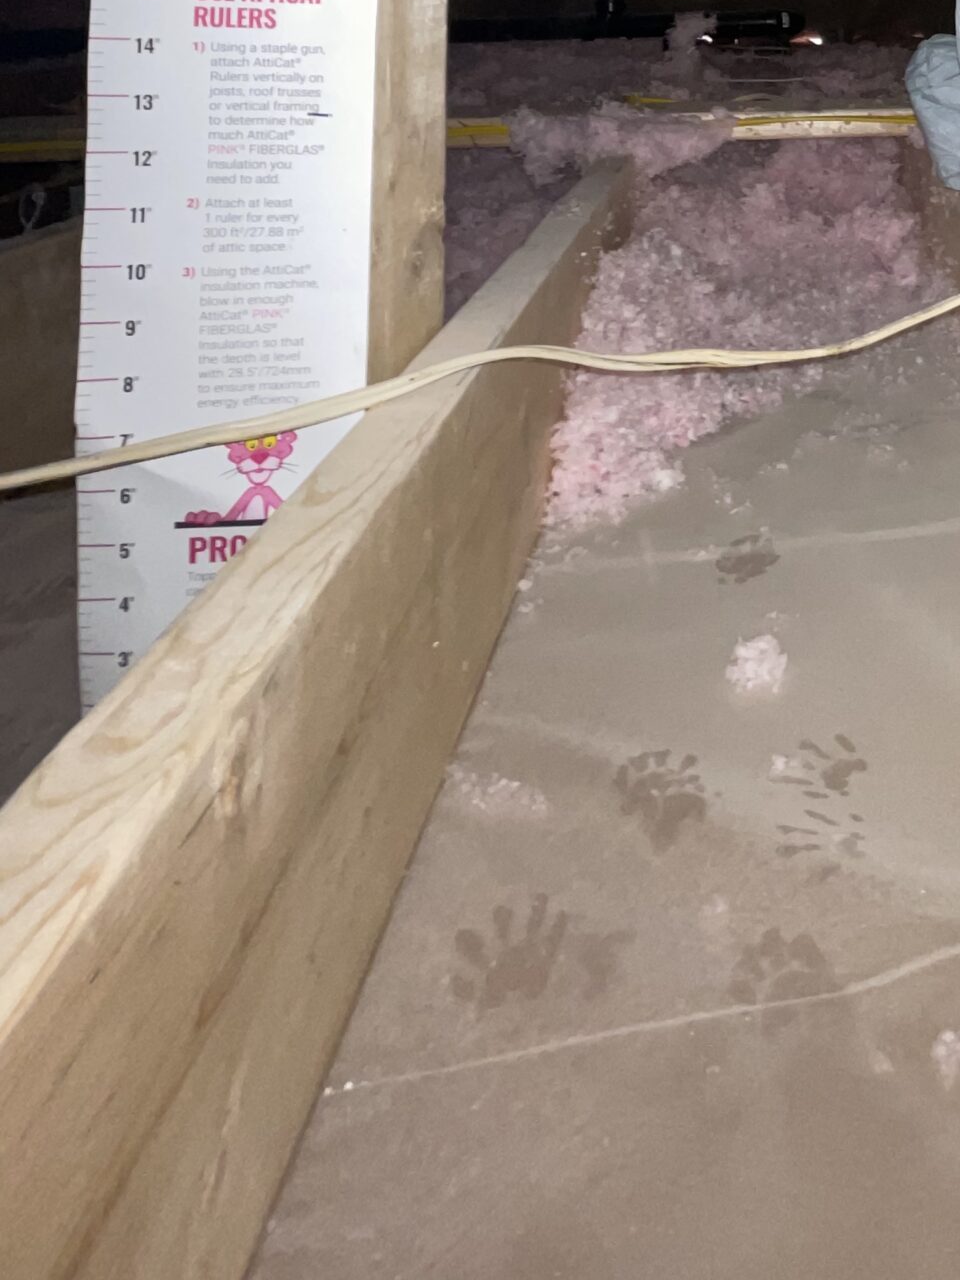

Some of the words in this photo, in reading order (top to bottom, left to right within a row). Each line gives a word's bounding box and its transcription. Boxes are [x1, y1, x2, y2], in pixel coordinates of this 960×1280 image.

[193, 6, 278, 29] RULERS
[210, 42, 247, 55] Using
[249, 43, 257, 53] a
[260, 42, 298, 55] staple
[210, 57, 250, 68] attach
[209, 70, 250, 82] Rulers
[252, 71, 306, 85] vertically
[308, 74, 324, 83] on
[249, 86, 274, 97] roof
[277, 87, 322, 98] trusses
[208, 102, 222, 111] or
[224, 100, 270, 111] vertical
[273, 101, 320, 114] framing
[208, 115, 222, 126] to
[224, 115, 287, 126] determine
[289, 116, 316, 126] how
[207, 129, 244, 141] much
[269, 160, 292, 172] you
[206, 173, 237, 184] need
[240, 174, 253, 184] to
[186, 197, 200, 210] 2)
[204, 197, 246, 209] Attach
[247, 198, 260, 208] at
[263, 197, 294, 208] least
[215, 212, 243, 223] ruler
[246, 211, 263, 223] for
[266, 213, 300, 225] every
[202, 241, 216, 253] of
[217, 242, 246, 253] attic
[182, 266, 196, 279] 3)
[200, 266, 237, 279] Using
[239, 265, 260, 276] the
[199, 295, 230, 307] blow
[231, 295, 246, 305] in
[247, 293, 294, 306] enough
